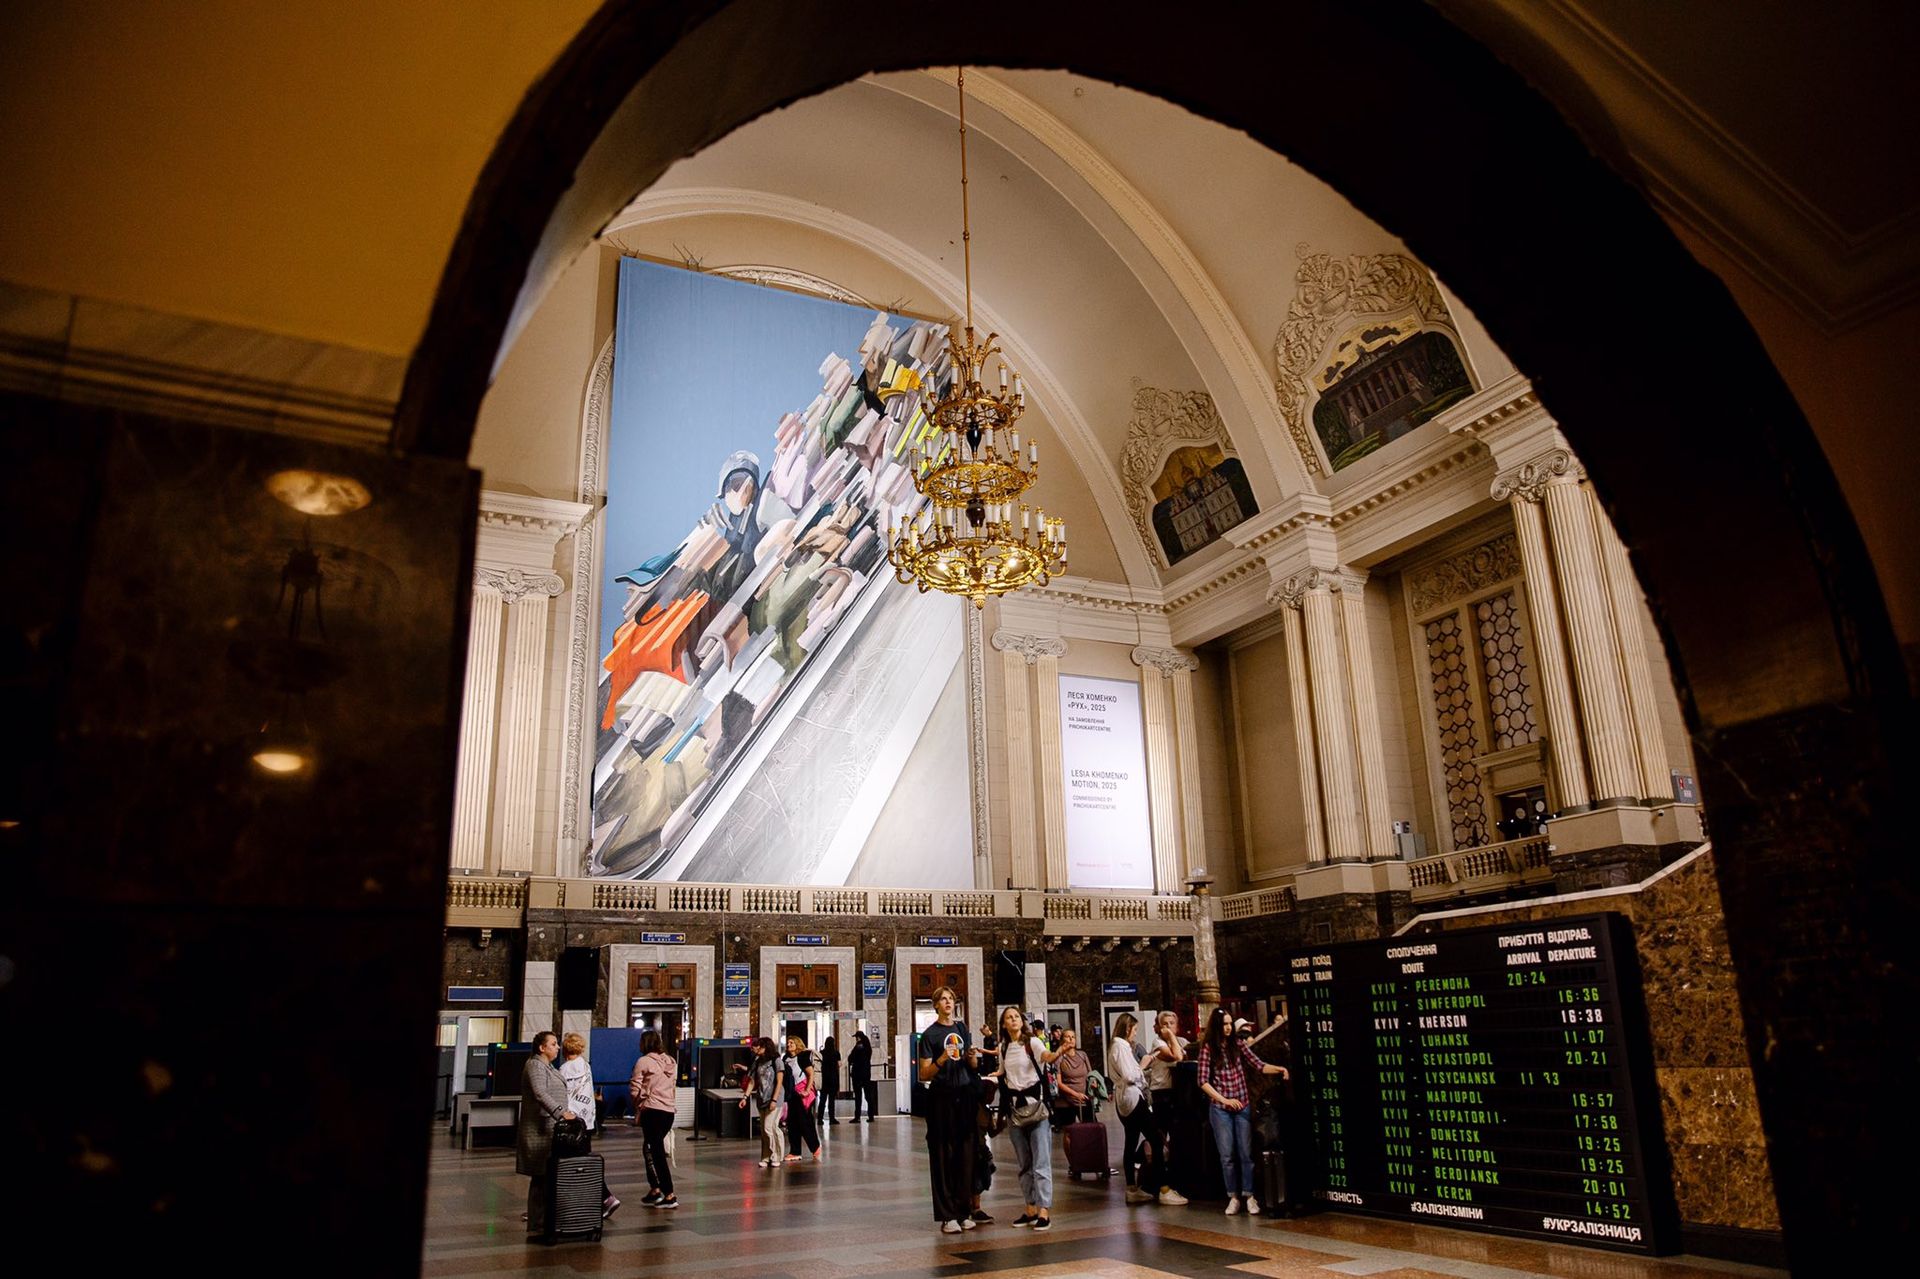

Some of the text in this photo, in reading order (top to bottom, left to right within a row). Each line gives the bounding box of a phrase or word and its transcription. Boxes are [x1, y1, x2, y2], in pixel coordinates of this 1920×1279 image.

[1067, 691, 1118, 703] ЛЕСЯ ХОМЕНКО
[1090, 703, 1107, 712] 2025
[1071, 769, 1128, 780] LESIA KHOMENKO
[1101, 781, 1118, 790] 2025
[1387, 944, 1437, 958] СПОЛУЧЕННЯ
[1499, 933, 1544, 948] ПРИБУТТЯ
[1548, 928, 1591, 944] ВІДПРАВ.
[1402, 962, 1424, 973] ROUTE
[1507, 952, 1541, 965] ARRIVAL
[1548, 946, 1596, 961] DEPARTURE
[1315, 989, 1328, 997] 111
[1372, 983, 1395, 994] KYIV
[1416, 977, 1470, 992] PEREMOHA
[1508, 971, 1545, 986] 20:24
[1373, 1001, 1396, 1011] KYIV
[1418, 995, 1485, 1010] SIMFEROPOL
[1559, 988, 1599, 1002] 16:36
[1318, 1021, 1333, 1032] 102
[1375, 1018, 1398, 1029] KYIV
[1419, 1015, 1467, 1028] KHERSON
[1562, 1009, 1602, 1023] 16:38
[1319, 1038, 1334, 1048] 520
[1377, 1036, 1400, 1047] KYIV
[1422, 1034, 1469, 1046] LUHANSK
[1325, 1055, 1336, 1065] 28
[1378, 1054, 1402, 1065] KYIV
[1424, 1053, 1492, 1065] SEVASTOPOL
[1327, 1072, 1337, 1082] 45
[1380, 1072, 1404, 1083] KYIV
[1426, 1072, 1495, 1084] LYSYCHANSK
[1382, 1090, 1405, 1101] KYIV
[1427, 1091, 1482, 1103] MARIUPOL
[1573, 1094, 1613, 1107] 16:57
[1383, 1108, 1407, 1119] KYIV
[1576, 1115, 1617, 1129] 17:58
[1385, 1126, 1409, 1138] KYIV
[1431, 1128, 1479, 1142] DONETSK
[1579, 1136, 1620, 1152] 19:25
[1387, 1144, 1411, 1157] KYIV
[1432, 1147, 1496, 1163] MELITOPOL
[1581, 1158, 1623, 1173] 19:25
[1388, 1163, 1412, 1176] KYIV
[1435, 1166, 1498, 1184] BERDIANSK
[1583, 1179, 1625, 1196] 20:01
[1330, 1175, 1346, 1187] 222
[1390, 1181, 1415, 1194] KYIV
[1437, 1186, 1472, 1200] KERCH
[1587, 1202, 1630, 1219] 14:52
[1411, 1202, 1483, 1219] #ЗАЛІЗНІЗМІНИ
[1543, 1215, 1641, 1241] #УКРЗАЛІЗНИЦЯ
